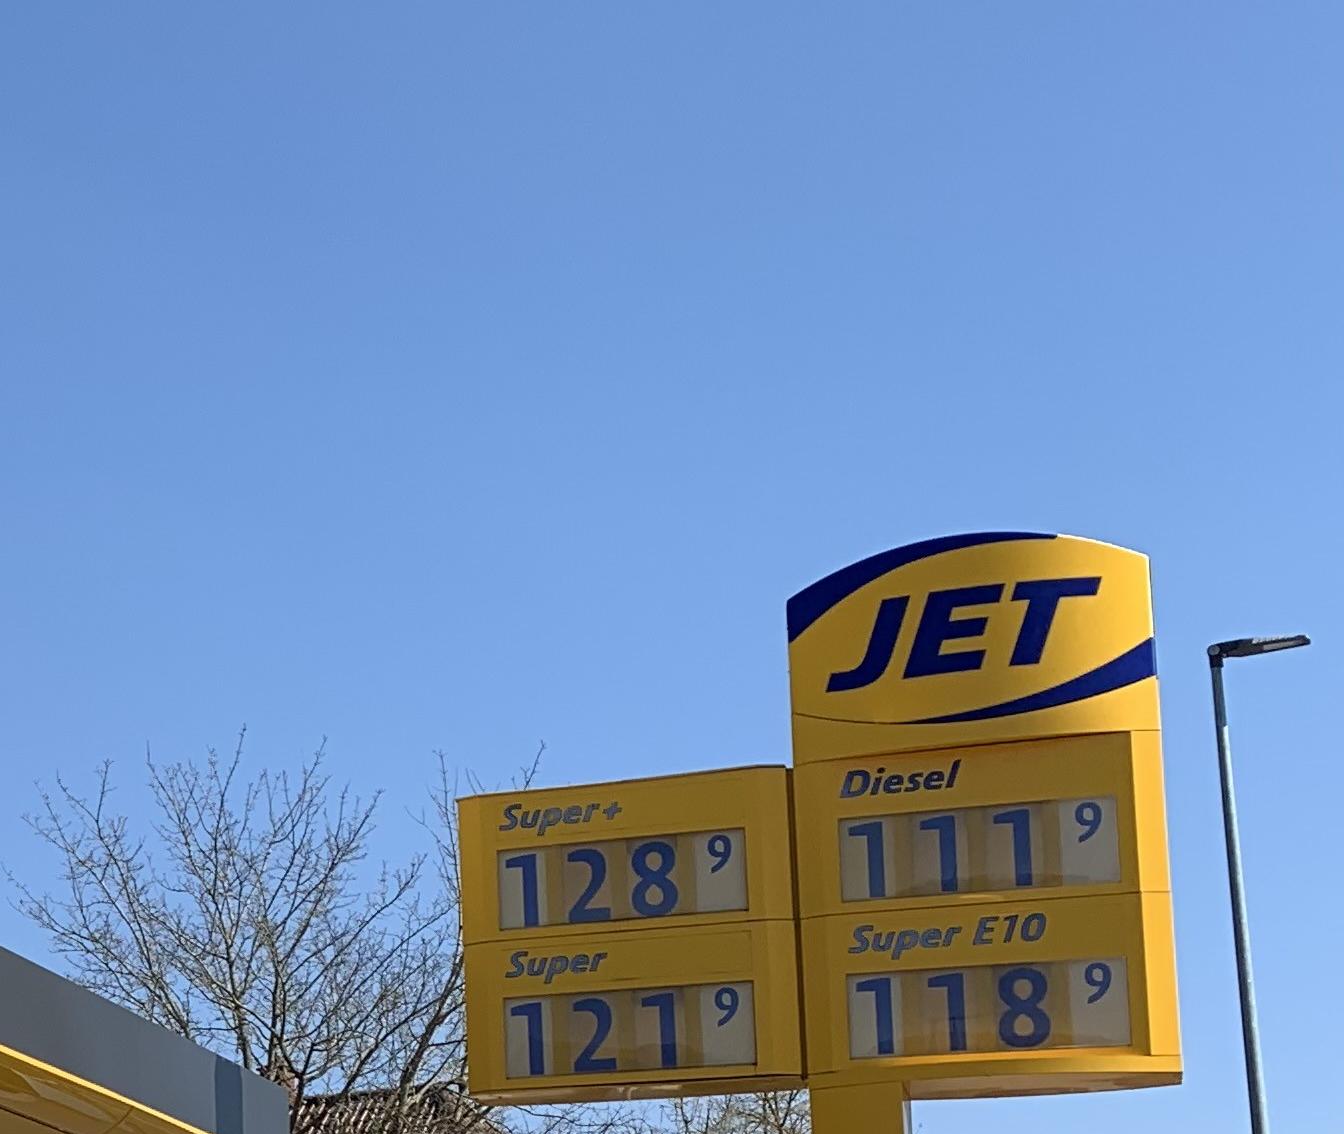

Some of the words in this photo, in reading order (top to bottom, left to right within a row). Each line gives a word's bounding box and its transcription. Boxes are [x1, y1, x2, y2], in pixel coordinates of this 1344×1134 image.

[826, 576, 1102, 693] JET
[839, 758, 962, 798] Diesel
[499, 802, 622, 836] Super+
[847, 925, 962, 960] Super
[972, 912, 1047, 946] E10
[505, 951, 608, 984] Super
